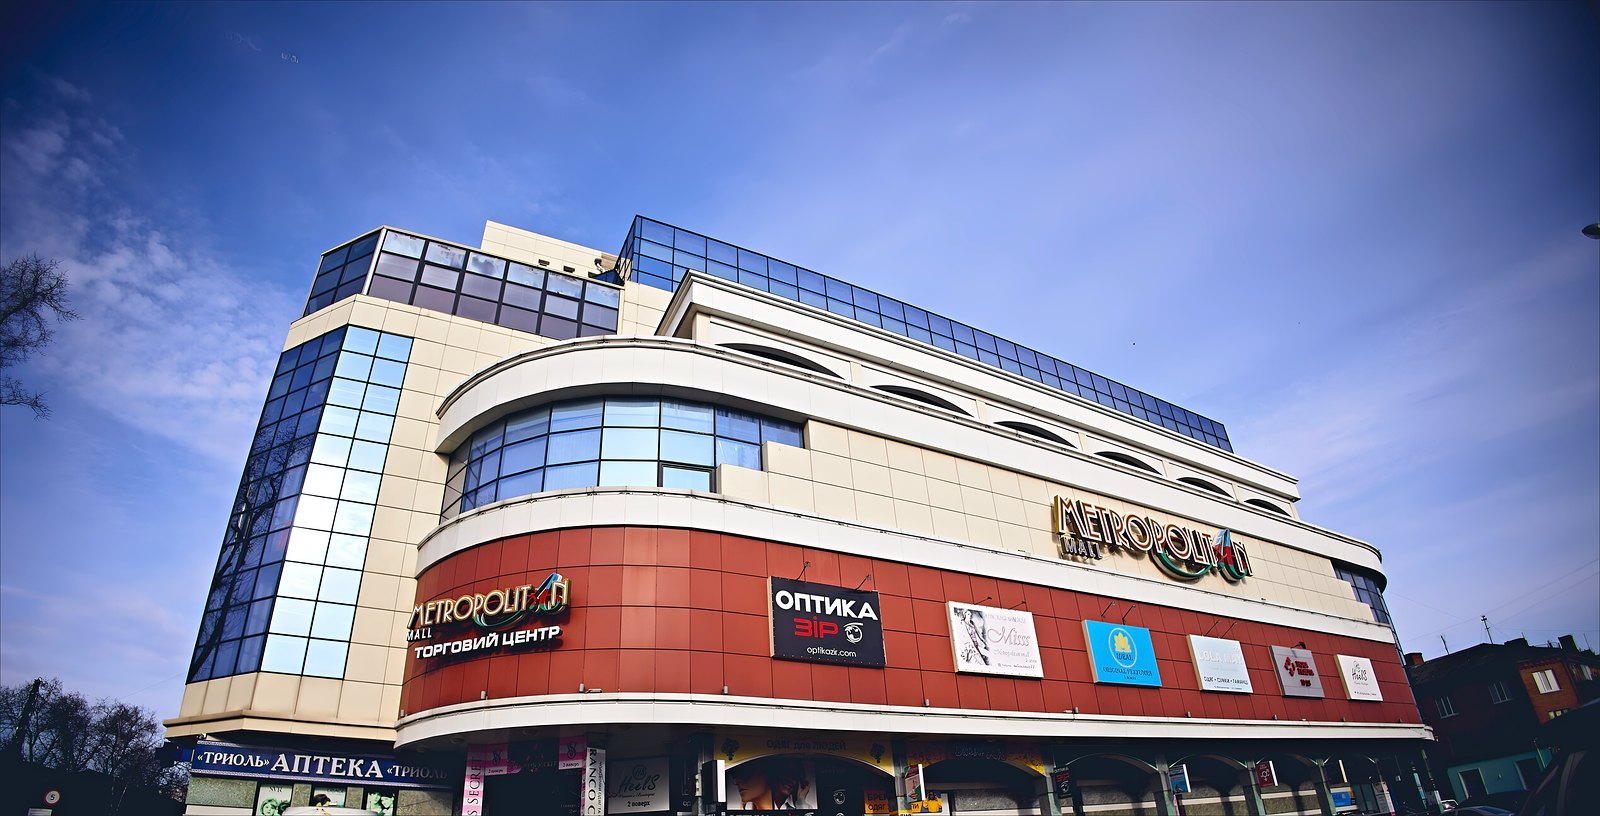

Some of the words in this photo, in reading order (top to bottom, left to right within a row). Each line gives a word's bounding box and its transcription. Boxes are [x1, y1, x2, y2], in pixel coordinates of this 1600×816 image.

[1054, 495, 1253, 578] METROPOLITAN
[1062, 535, 1103, 559] MALL
[407, 573, 572, 629] METROPOLITAN
[775, 590, 879, 621] ОПТИКА
[406, 627, 432, 642] MALL
[414, 631, 499, 659] ТОРГОВИЙ
[502, 625, 561, 646] ЦЕНТР
[806, 646, 857, 658] optikazir.com
[197, 751, 270, 769] «ТРИОЛЬ»
[270, 753, 384, 779] АПТЕКА
[467, 756, 482, 805] SECRET
